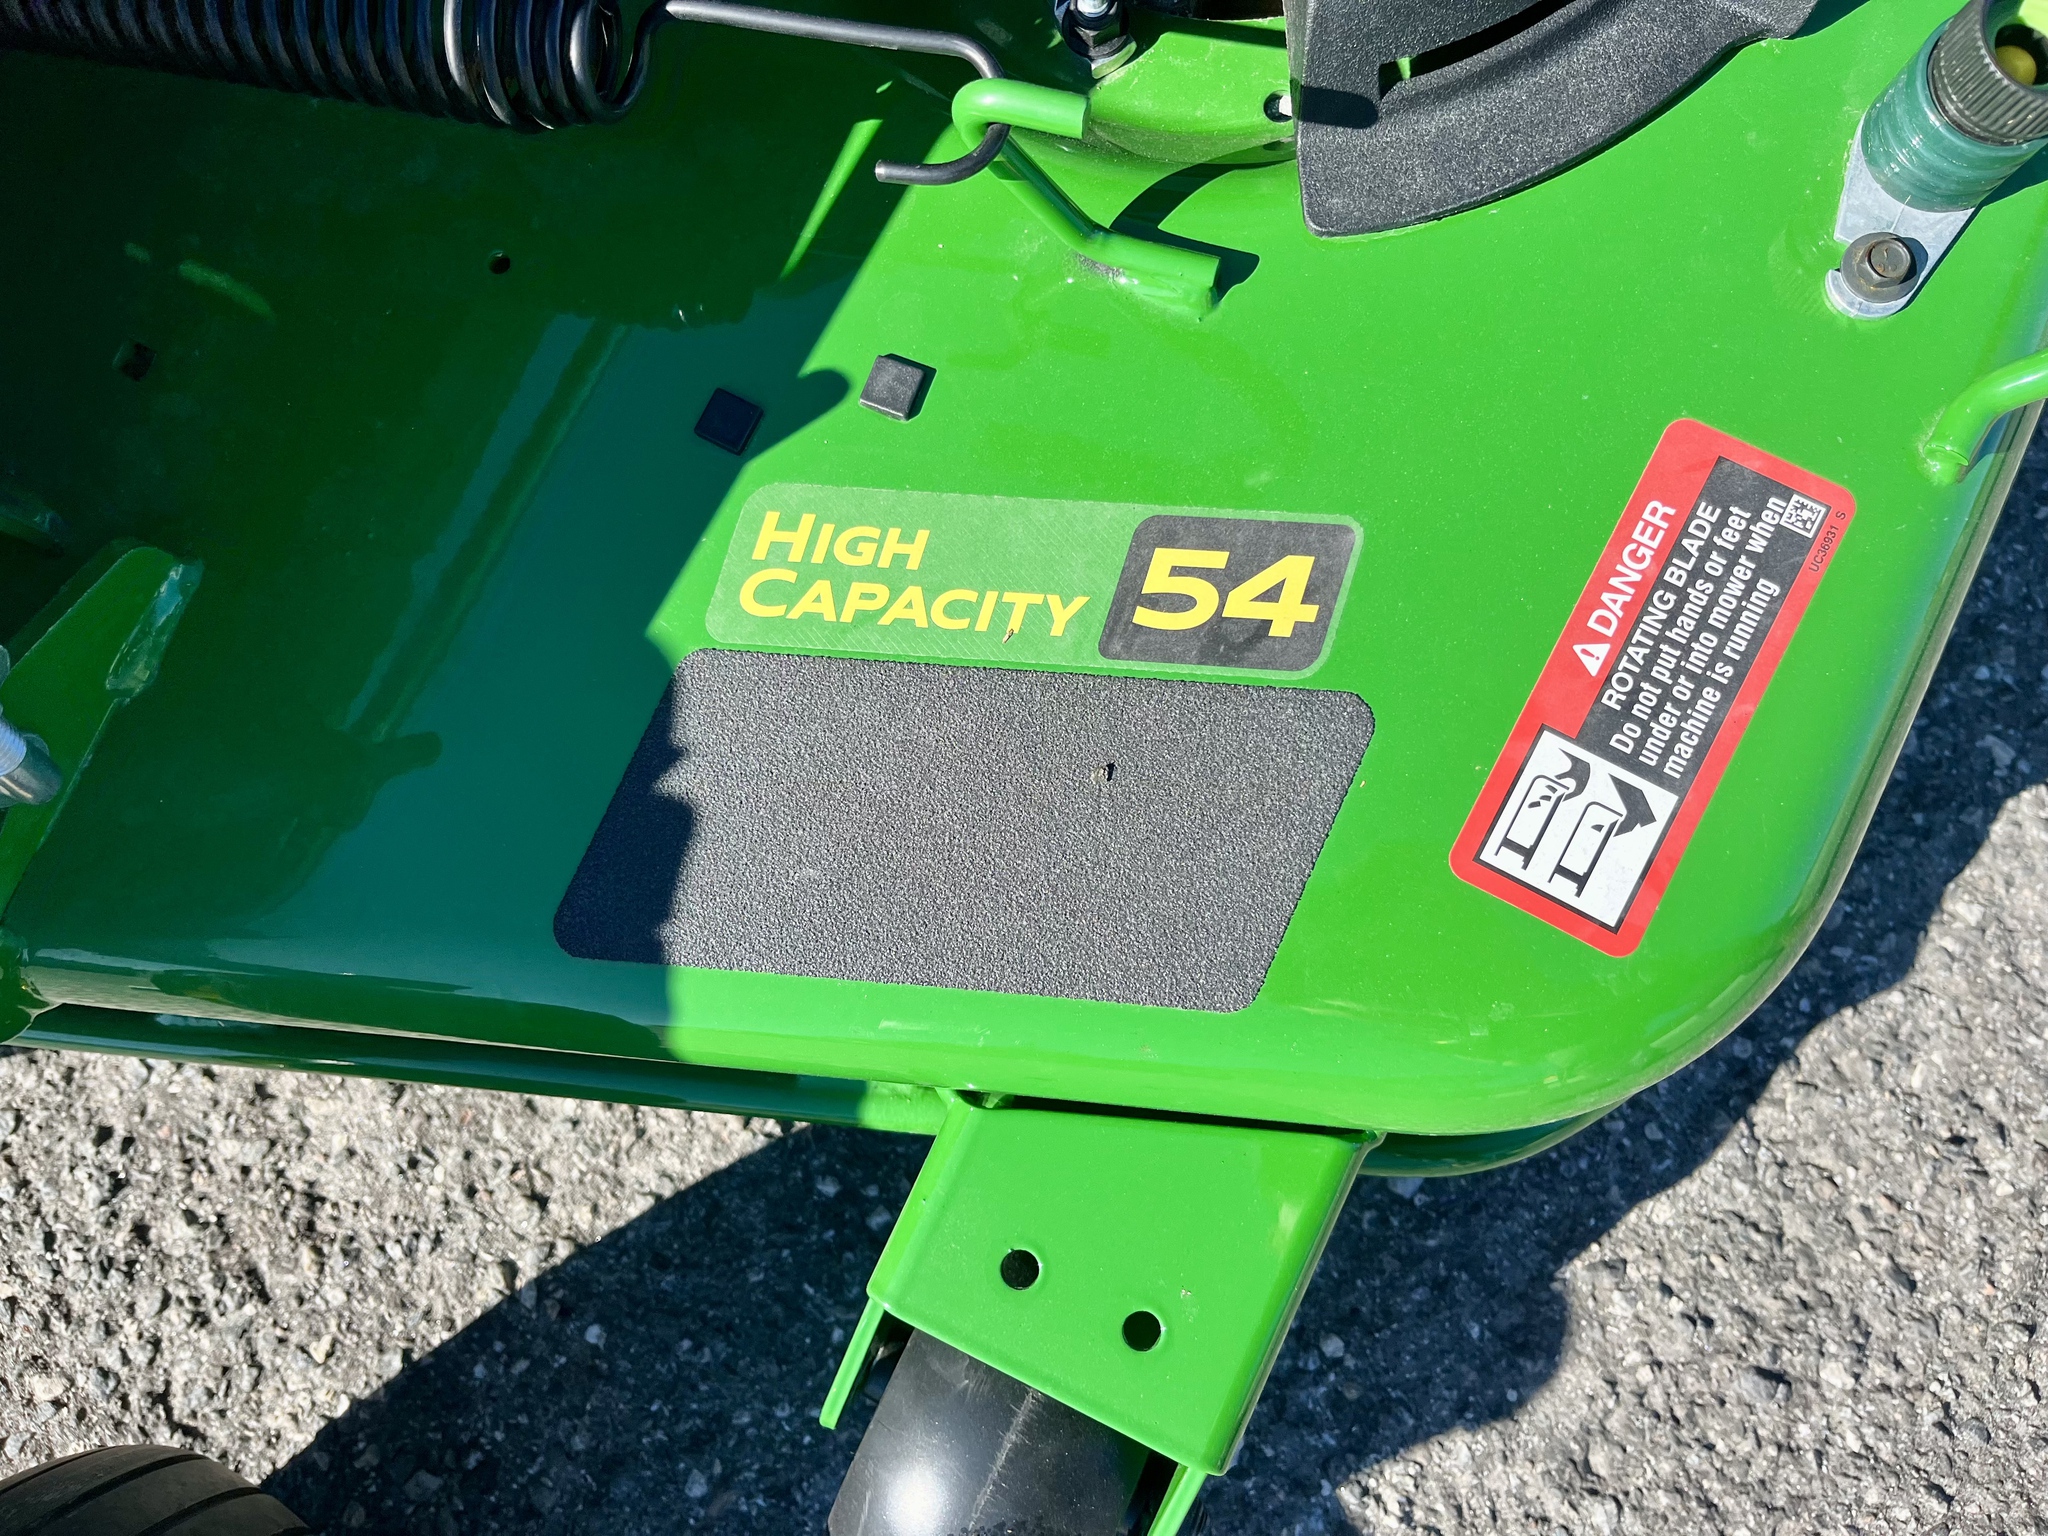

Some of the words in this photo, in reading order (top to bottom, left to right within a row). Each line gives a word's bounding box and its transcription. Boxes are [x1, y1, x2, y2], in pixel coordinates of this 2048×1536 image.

[752, 511, 930, 570] HIGH
[1713, 505, 1752, 551] feet
[1744, 496, 1787, 554] when
[1809, 525, 1839, 572] UC36931
[1835, 510, 1846, 520] S
[1132, 548, 1319, 637] 54
[1587, 501, 1676, 637] DANGER
[1704, 550, 1728, 577] or
[1707, 554, 1757, 630] mower
[740, 568, 1090, 637] CAPACITY
[1601, 590, 1677, 711] ROTATING
[1663, 500, 1721, 588] BLADE
[1664, 578, 1714, 645] hands
[1650, 643, 1682, 685] put
[1662, 686, 1722, 779] machine
[1705, 661, 1735, 685] is
[1722, 577, 1781, 661] running
[1680, 631, 1719, 675] into
[1631, 681, 1662, 721] not
[1671, 674, 1695, 701] or
[1609, 722, 1641, 754] Do
[1638, 701, 1682, 767] under
